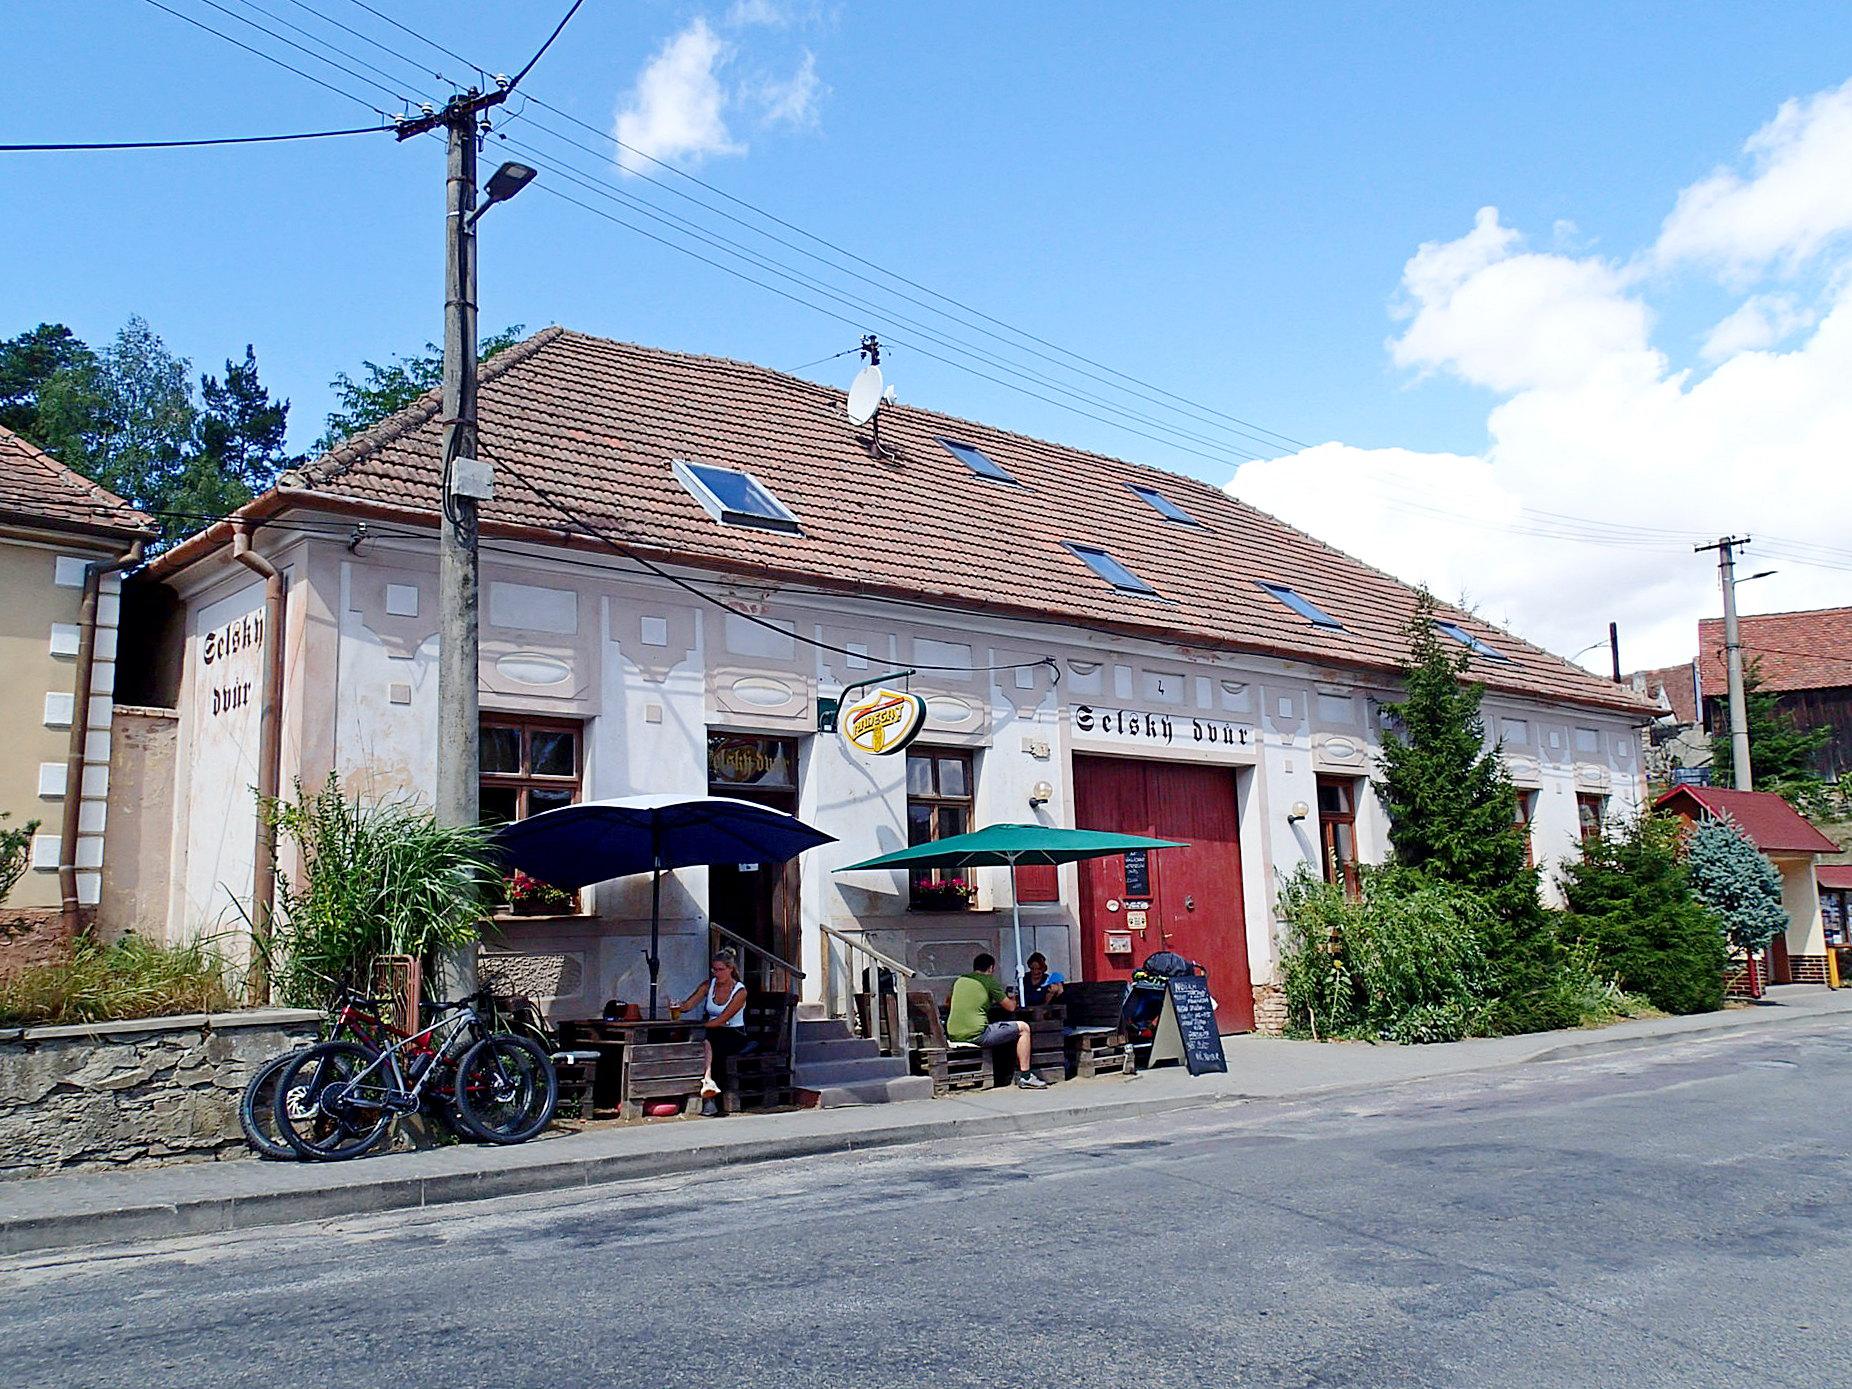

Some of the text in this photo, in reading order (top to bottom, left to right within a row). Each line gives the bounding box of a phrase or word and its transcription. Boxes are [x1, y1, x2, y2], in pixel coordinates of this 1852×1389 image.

[203, 609, 264, 665] Selský
[213, 677, 251, 716] dvůr
[1158, 679, 1165, 696] 4
[853, 704, 904, 737] RADEGAST
[1076, 704, 1248, 746] Selský dvůr
